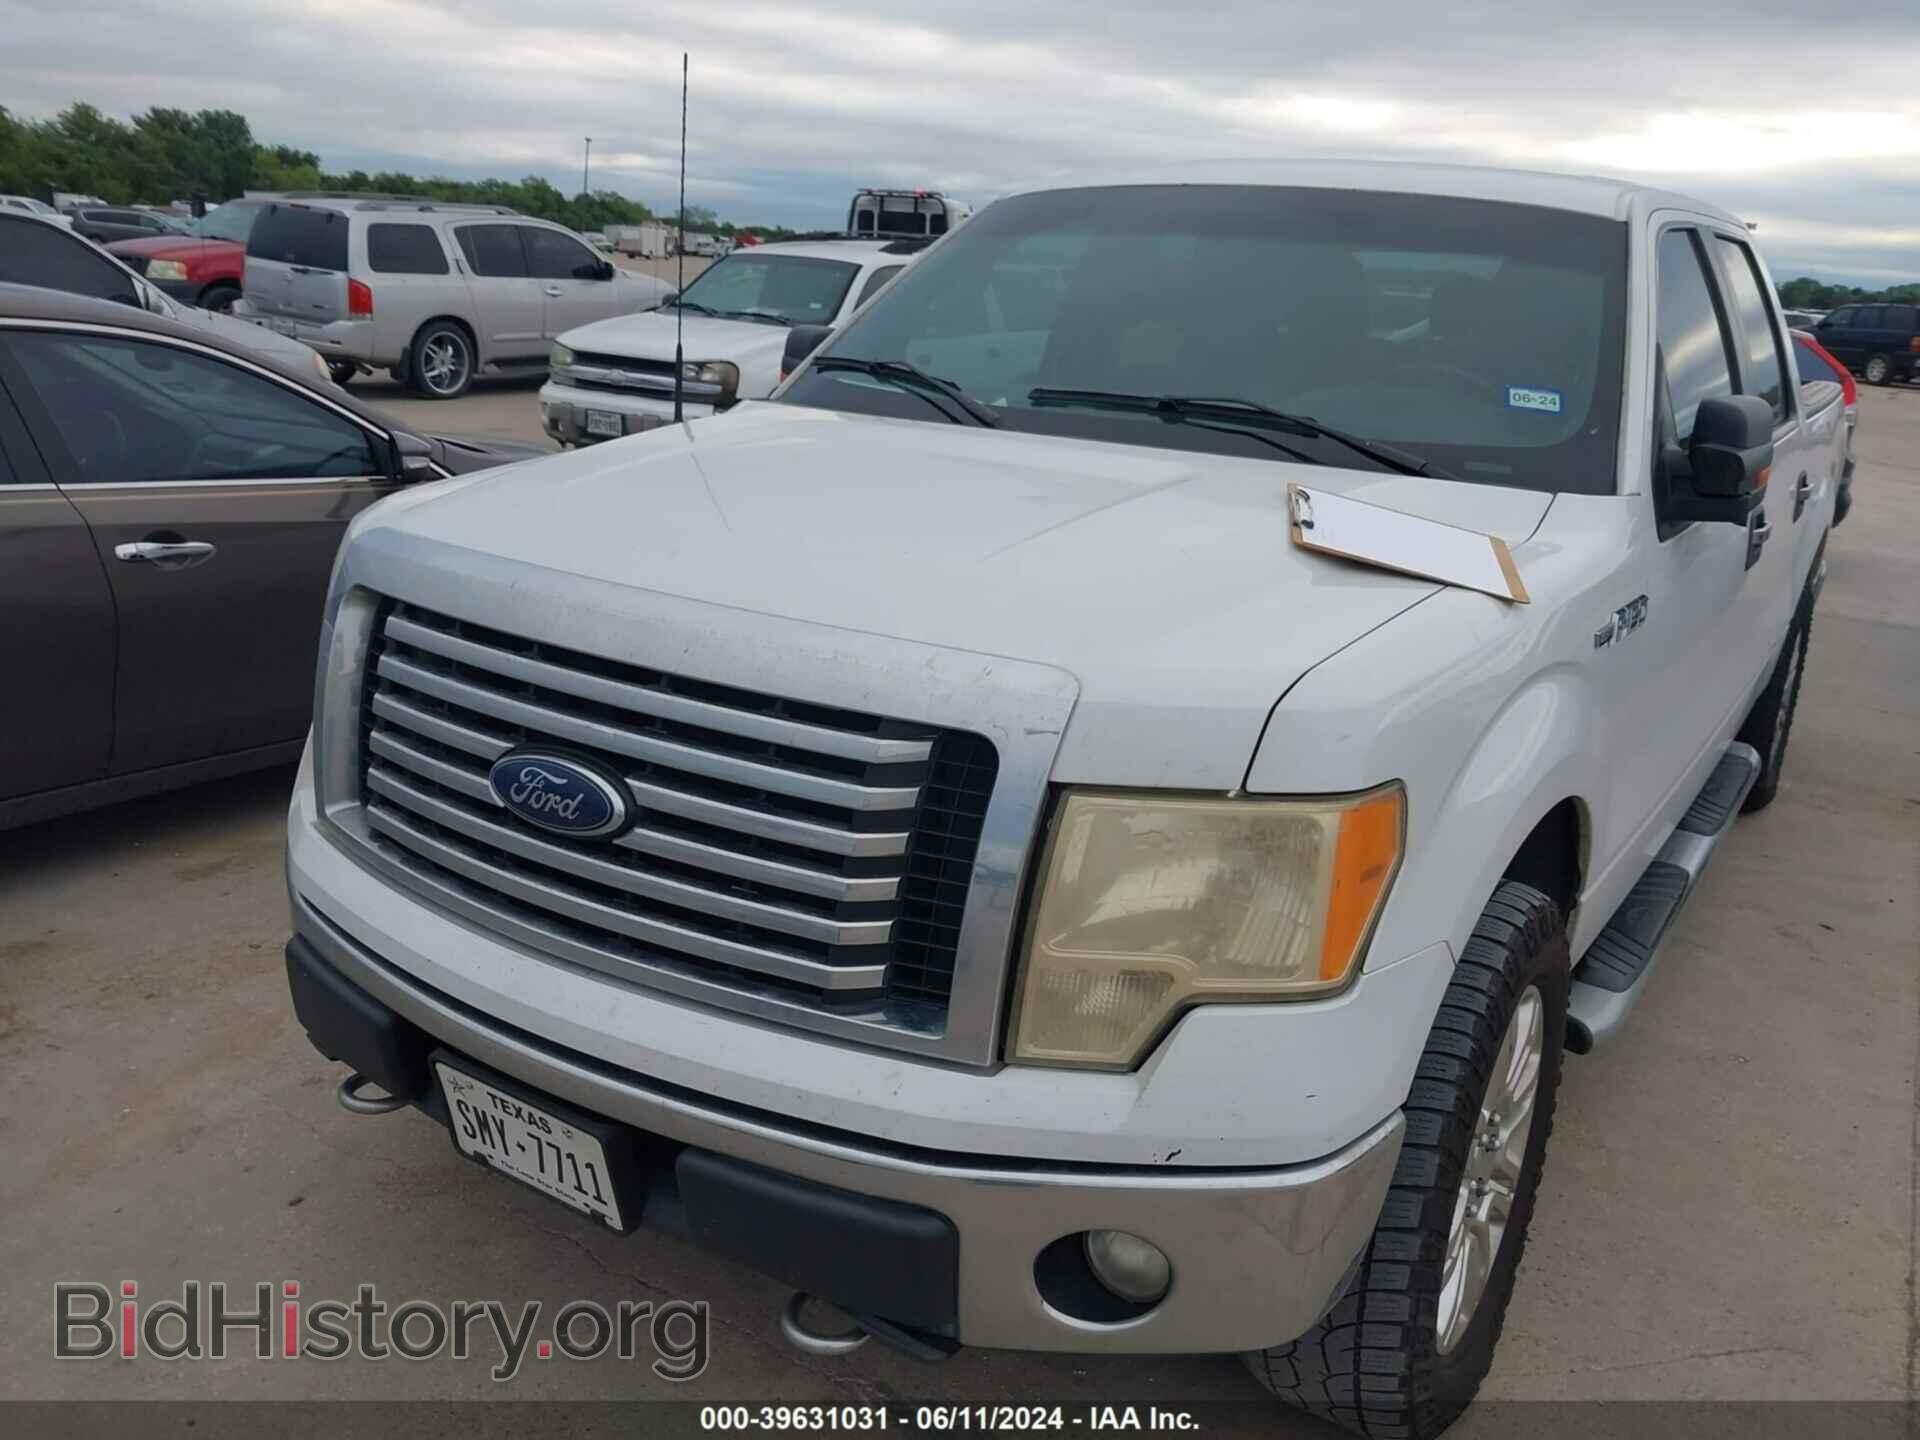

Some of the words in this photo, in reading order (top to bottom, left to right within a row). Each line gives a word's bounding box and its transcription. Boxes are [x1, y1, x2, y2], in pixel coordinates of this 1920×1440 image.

[1512, 391, 1557, 407] 06-24
[510, 766, 584, 820] Ford
[486, 1091, 552, 1135] TEXAS
